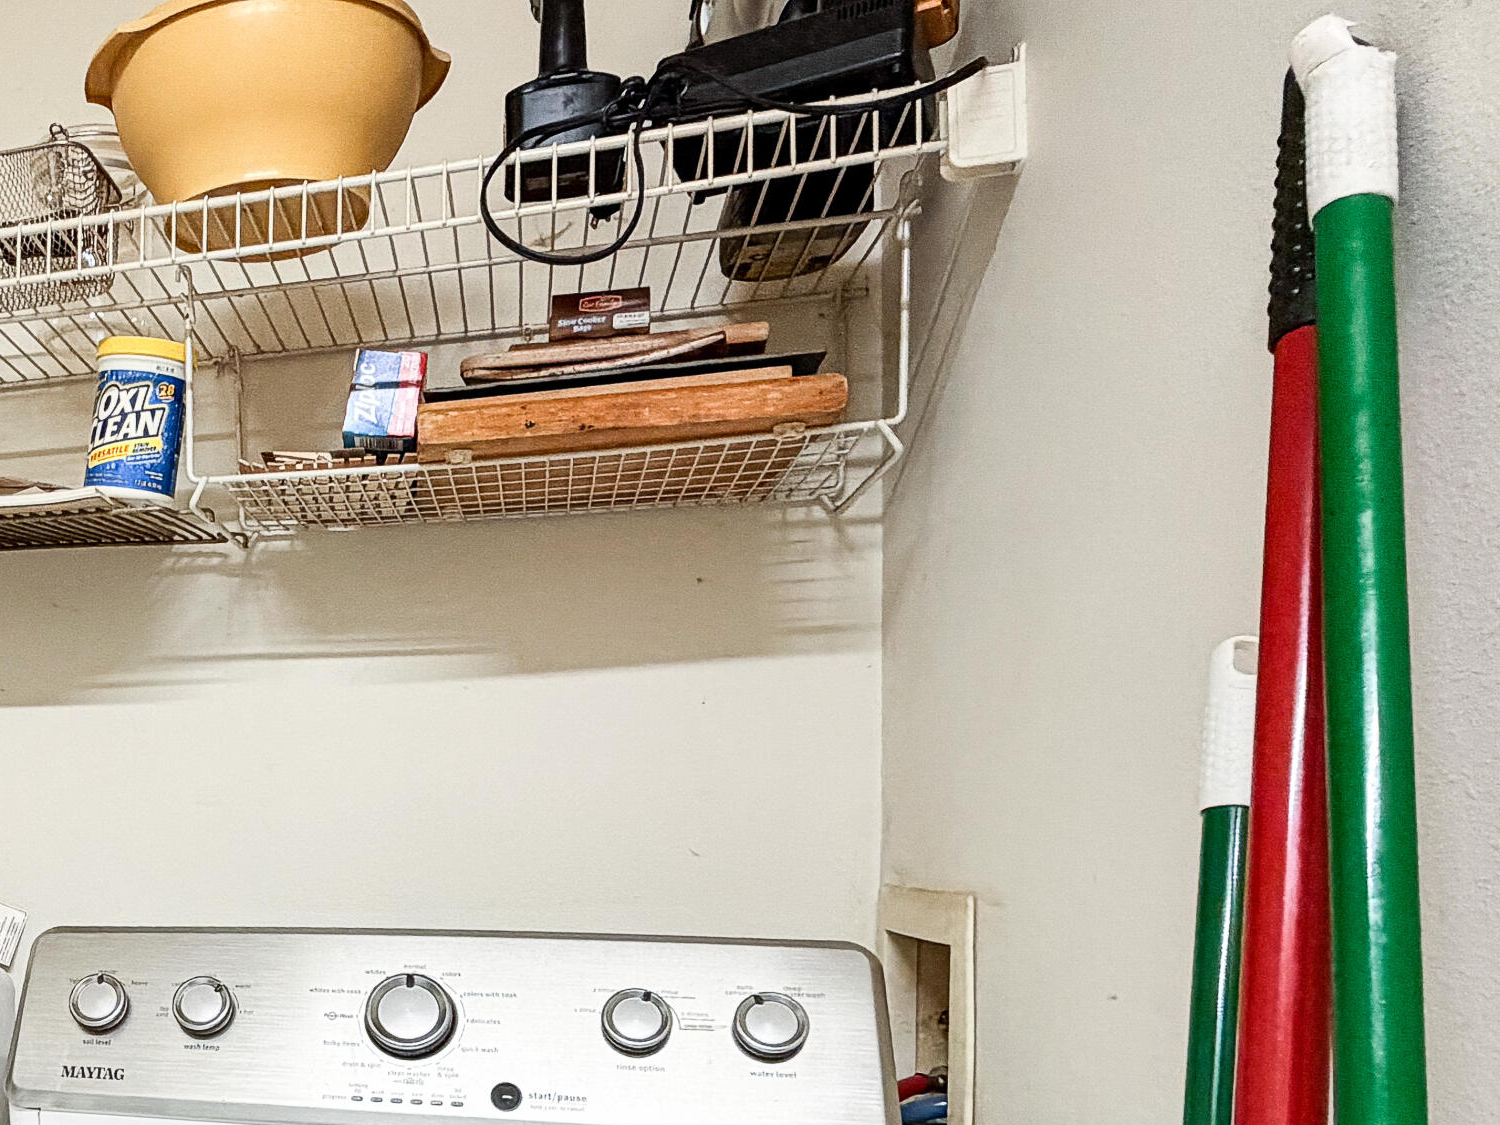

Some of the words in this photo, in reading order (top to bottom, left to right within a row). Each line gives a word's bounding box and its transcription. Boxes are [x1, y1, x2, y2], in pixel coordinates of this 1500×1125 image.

[578, 316, 607, 325] Cooker
[158, 384, 175, 398] 28
[98, 384, 149, 420] OXI
[95, 1038, 112, 1046] level
[202, 1043, 220, 1052] temp
[61, 1065, 125, 1081] MAYTAG
[528, 1092, 588, 1103] start/pause
